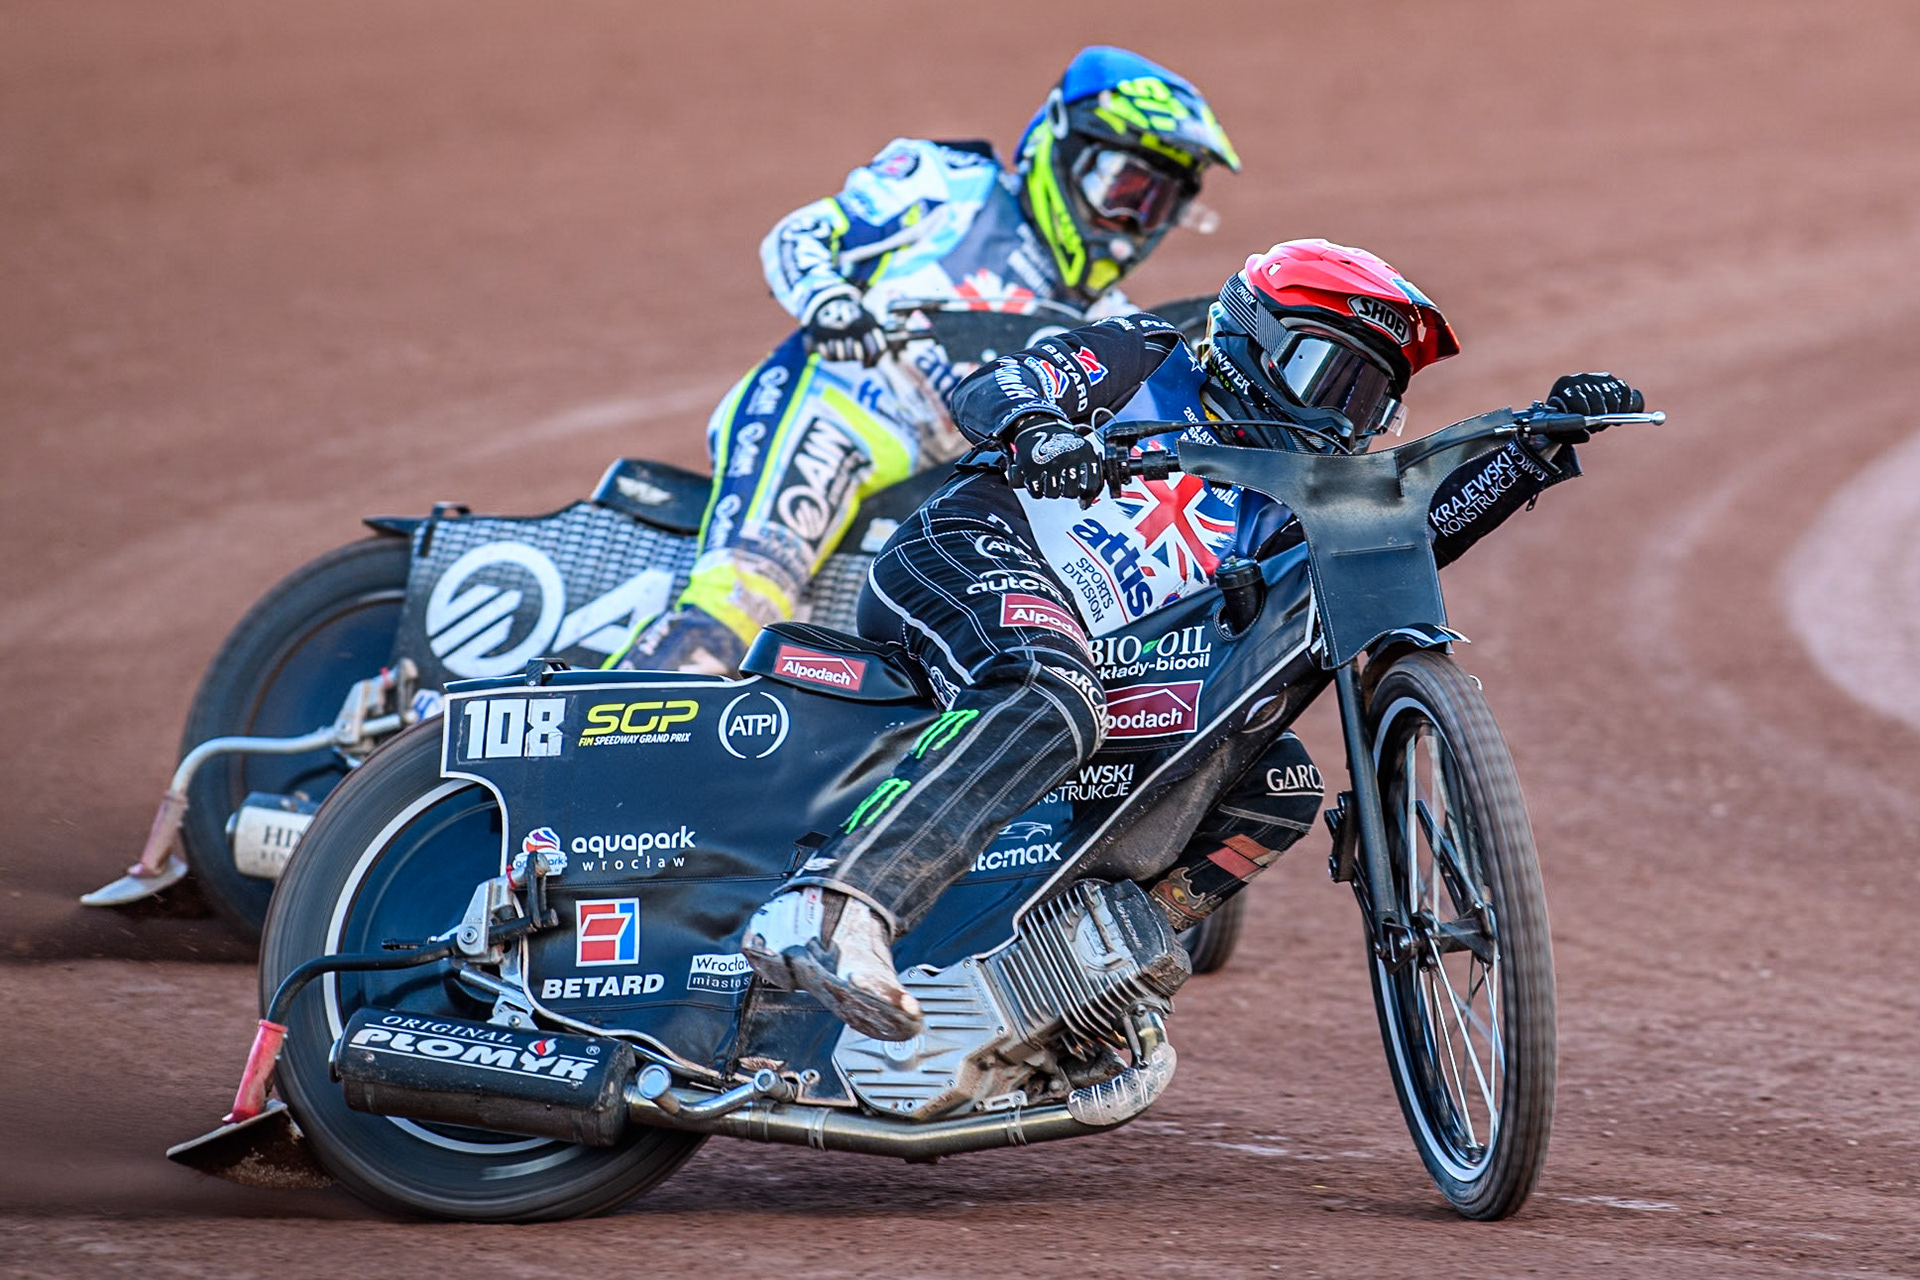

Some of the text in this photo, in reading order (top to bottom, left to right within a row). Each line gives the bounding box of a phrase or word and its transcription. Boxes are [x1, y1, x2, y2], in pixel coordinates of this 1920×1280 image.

[1358, 296, 1408, 340] SHOEI
[1041, 344, 1088, 412] BETARD
[1429, 451, 1513, 527] KRAJEWSKI
[1439, 465, 1522, 537] KONSTRUKCJE
[1072, 518, 1156, 617] attis
[1076, 557, 1114, 609] SPORTS
[1061, 562, 1105, 623] DIVISION
[782, 660, 851, 686] Alpodach
[1097, 653, 1210, 681] kłady-biooil
[465, 698, 566, 760] 108
[582, 700, 699, 736] SGP
[728, 713, 777, 737] ATPI
[1107, 708, 1182, 730] podach
[578, 732, 691, 746] FIM SPEEDWAY GRAND PRIX
[571, 826, 696, 858] aquapark
[582, 854, 685, 871] wrocław
[541, 973, 665, 999] BETARD
[693, 976, 741, 988] miasto
[382, 1015, 513, 1043] ORIGINAL
